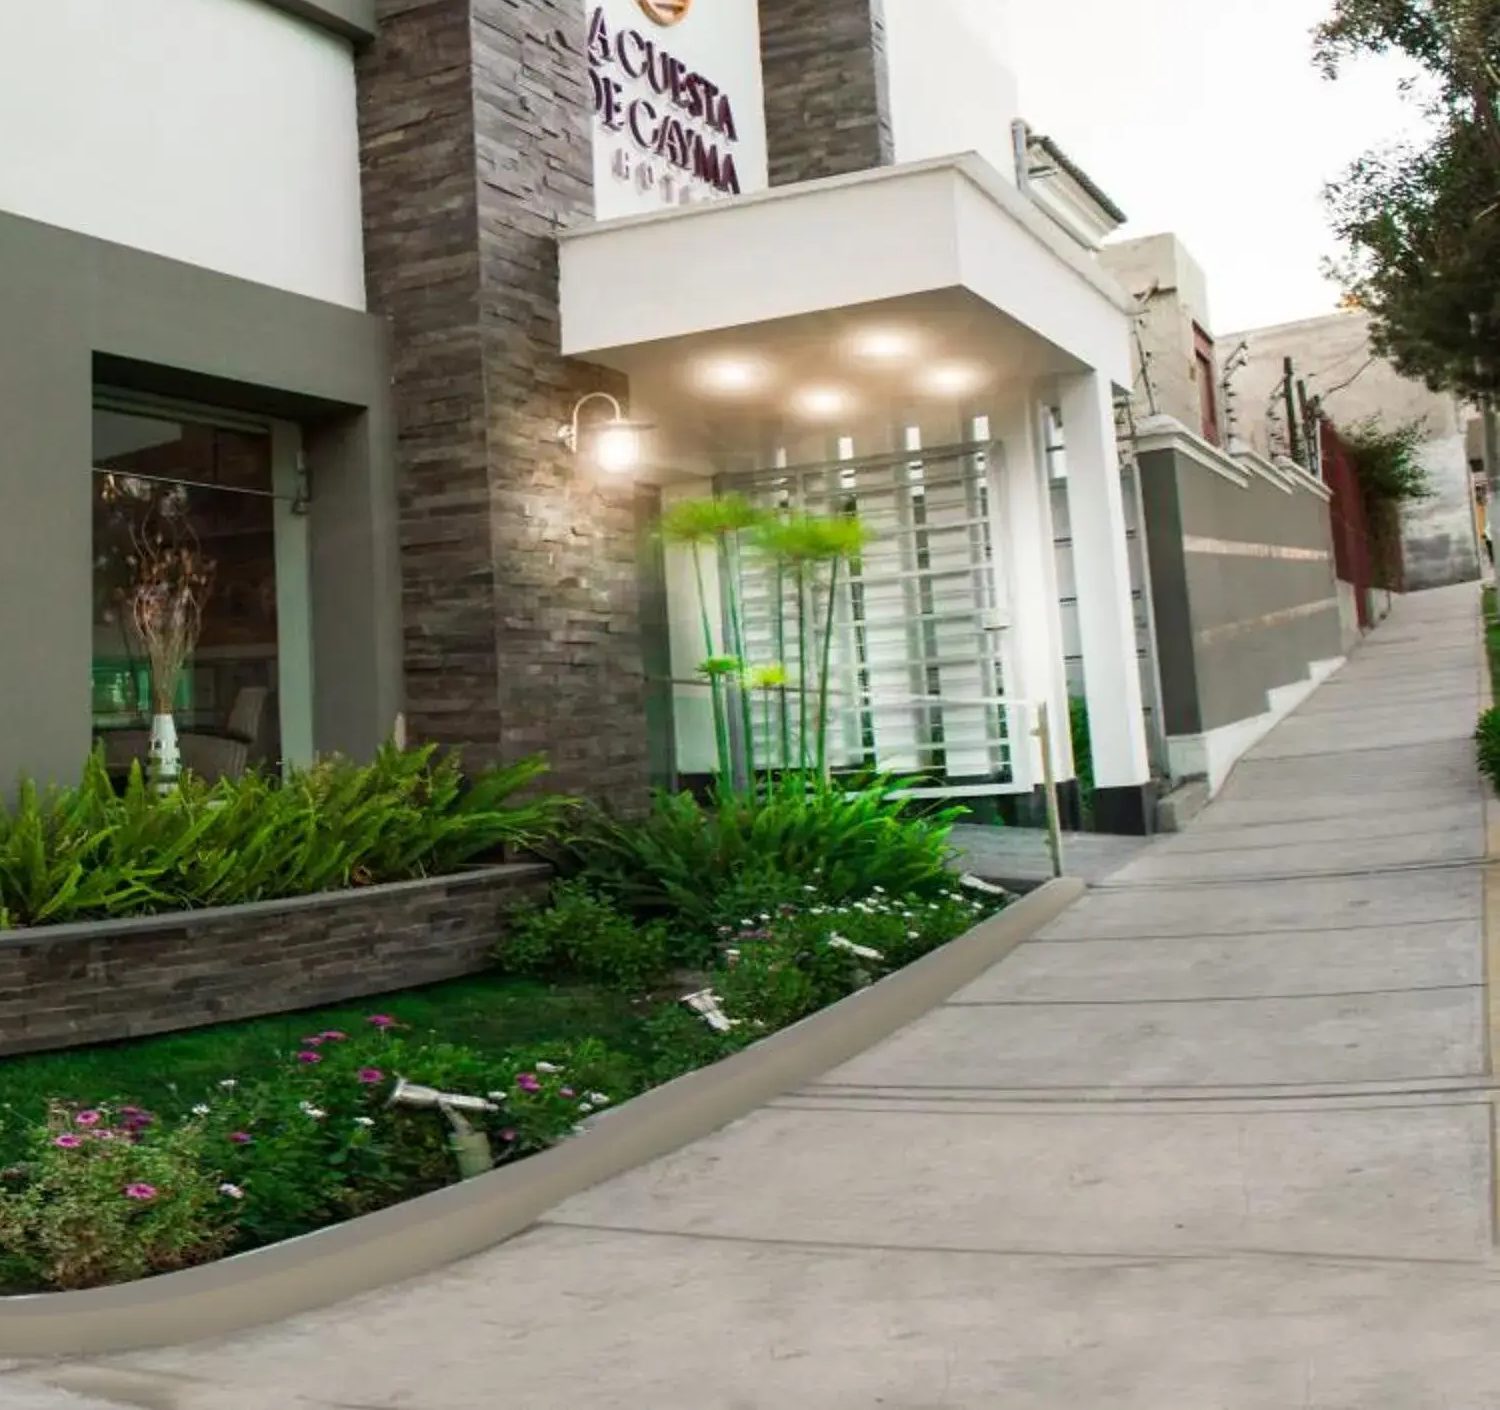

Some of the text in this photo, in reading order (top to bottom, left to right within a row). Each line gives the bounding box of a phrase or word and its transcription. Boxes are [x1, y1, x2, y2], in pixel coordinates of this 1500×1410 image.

[588, 6, 739, 142] A CUESTA
[629, 99, 741, 196] CAYMA
